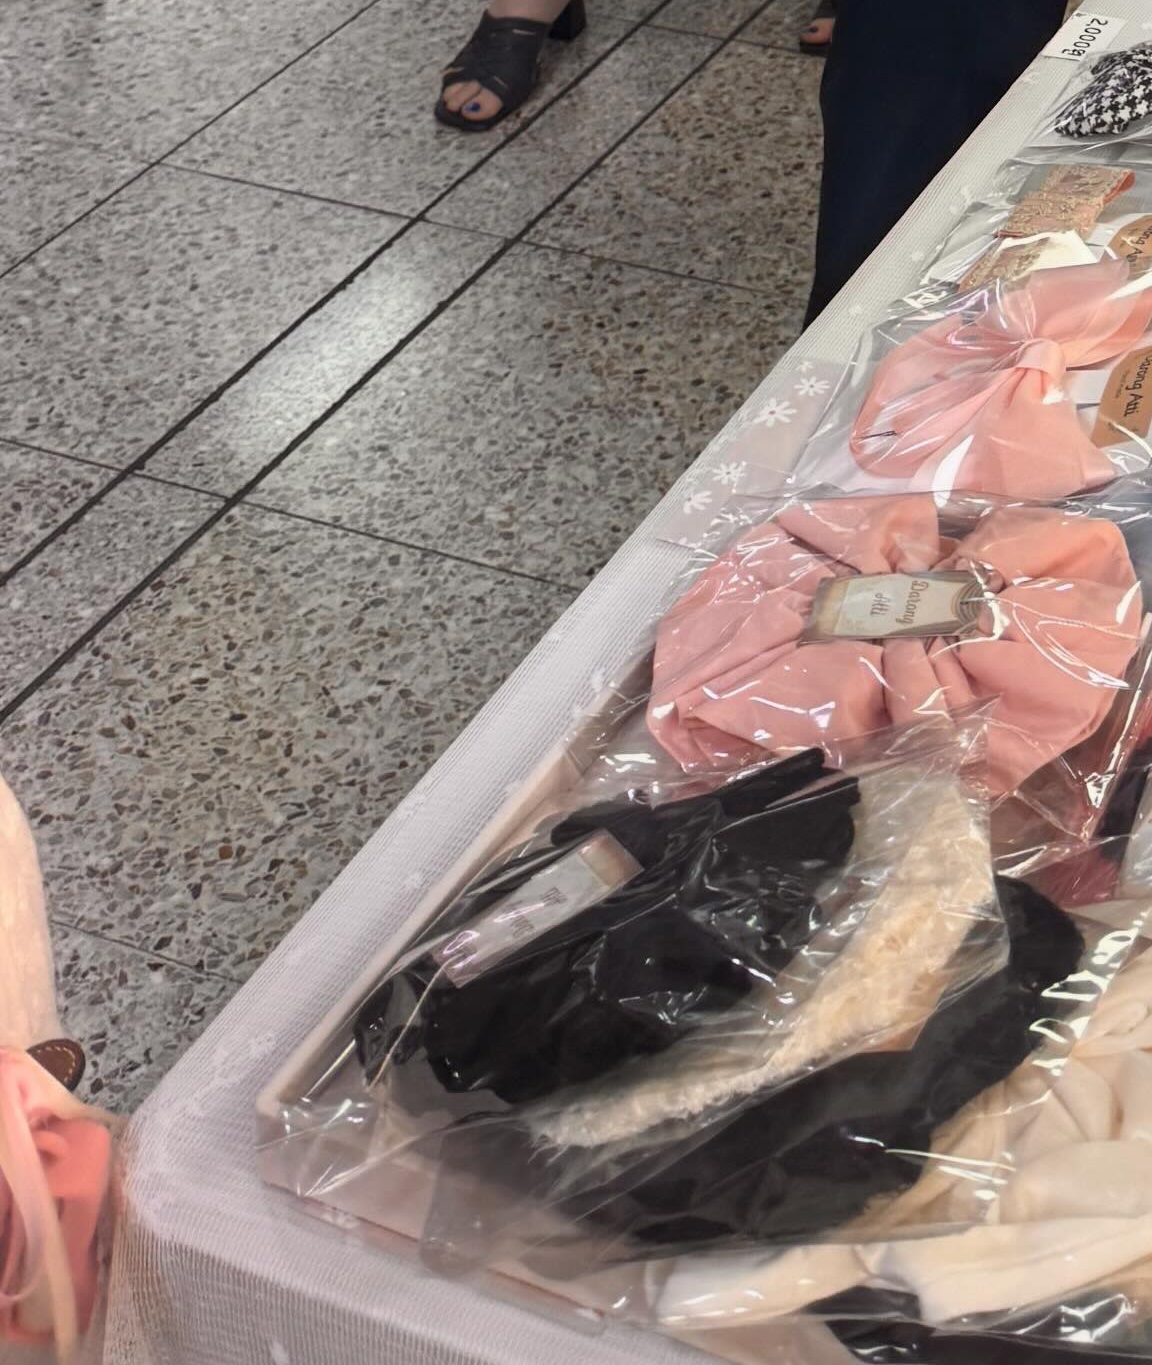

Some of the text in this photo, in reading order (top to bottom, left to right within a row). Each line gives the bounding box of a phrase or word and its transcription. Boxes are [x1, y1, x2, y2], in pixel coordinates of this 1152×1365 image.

[1061, 17, 1109, 57] 2,000원
[1122, 393, 1144, 418] Atti
[895, 580, 929, 625] Darong
